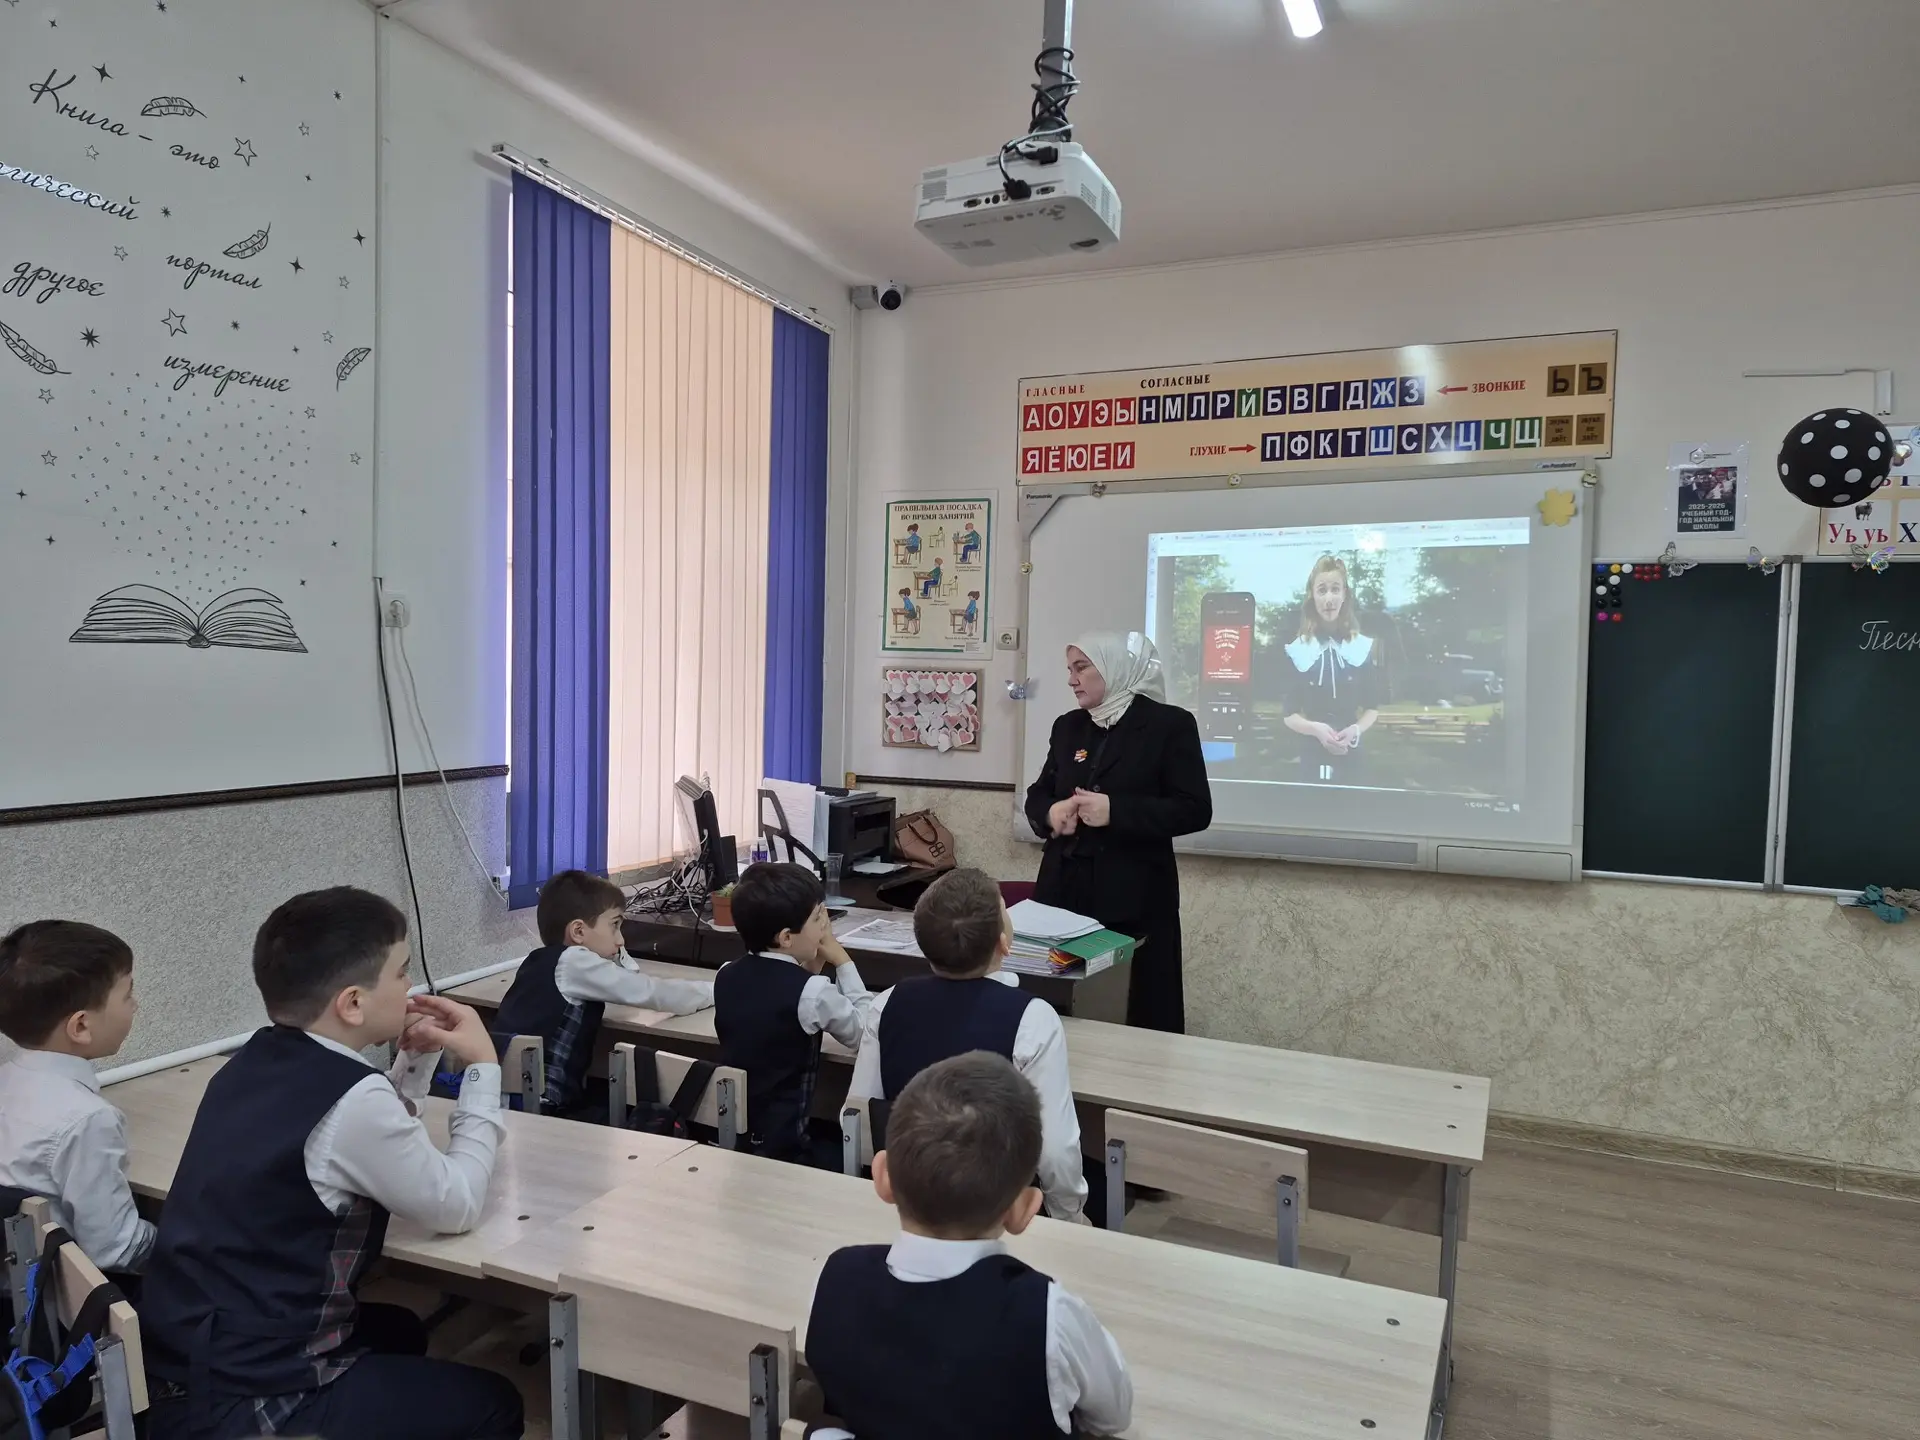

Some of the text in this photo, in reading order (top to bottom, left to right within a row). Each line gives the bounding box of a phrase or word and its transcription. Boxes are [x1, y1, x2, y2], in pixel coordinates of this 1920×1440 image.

[29, 68, 130, 137] Книга
[169, 143, 221, 170] это
[166, 253, 263, 290] портал
[2, 261, 105, 304] другое
[164, 355, 292, 397] измерение
[1140, 374, 1211, 389] СОГЛАСНЫЕ
[1026, 384, 1086, 398] ГЛАСНЫЕ
[1471, 380, 1526, 394] ЗВОНКИЕ
[1190, 445, 1227, 457] ГЛУХИЕ
[894, 503, 982, 512] ПРАВИЛЬНАЯ ПОСАДКА
[938, 512, 975, 520] ЗАНЯТИЙ
